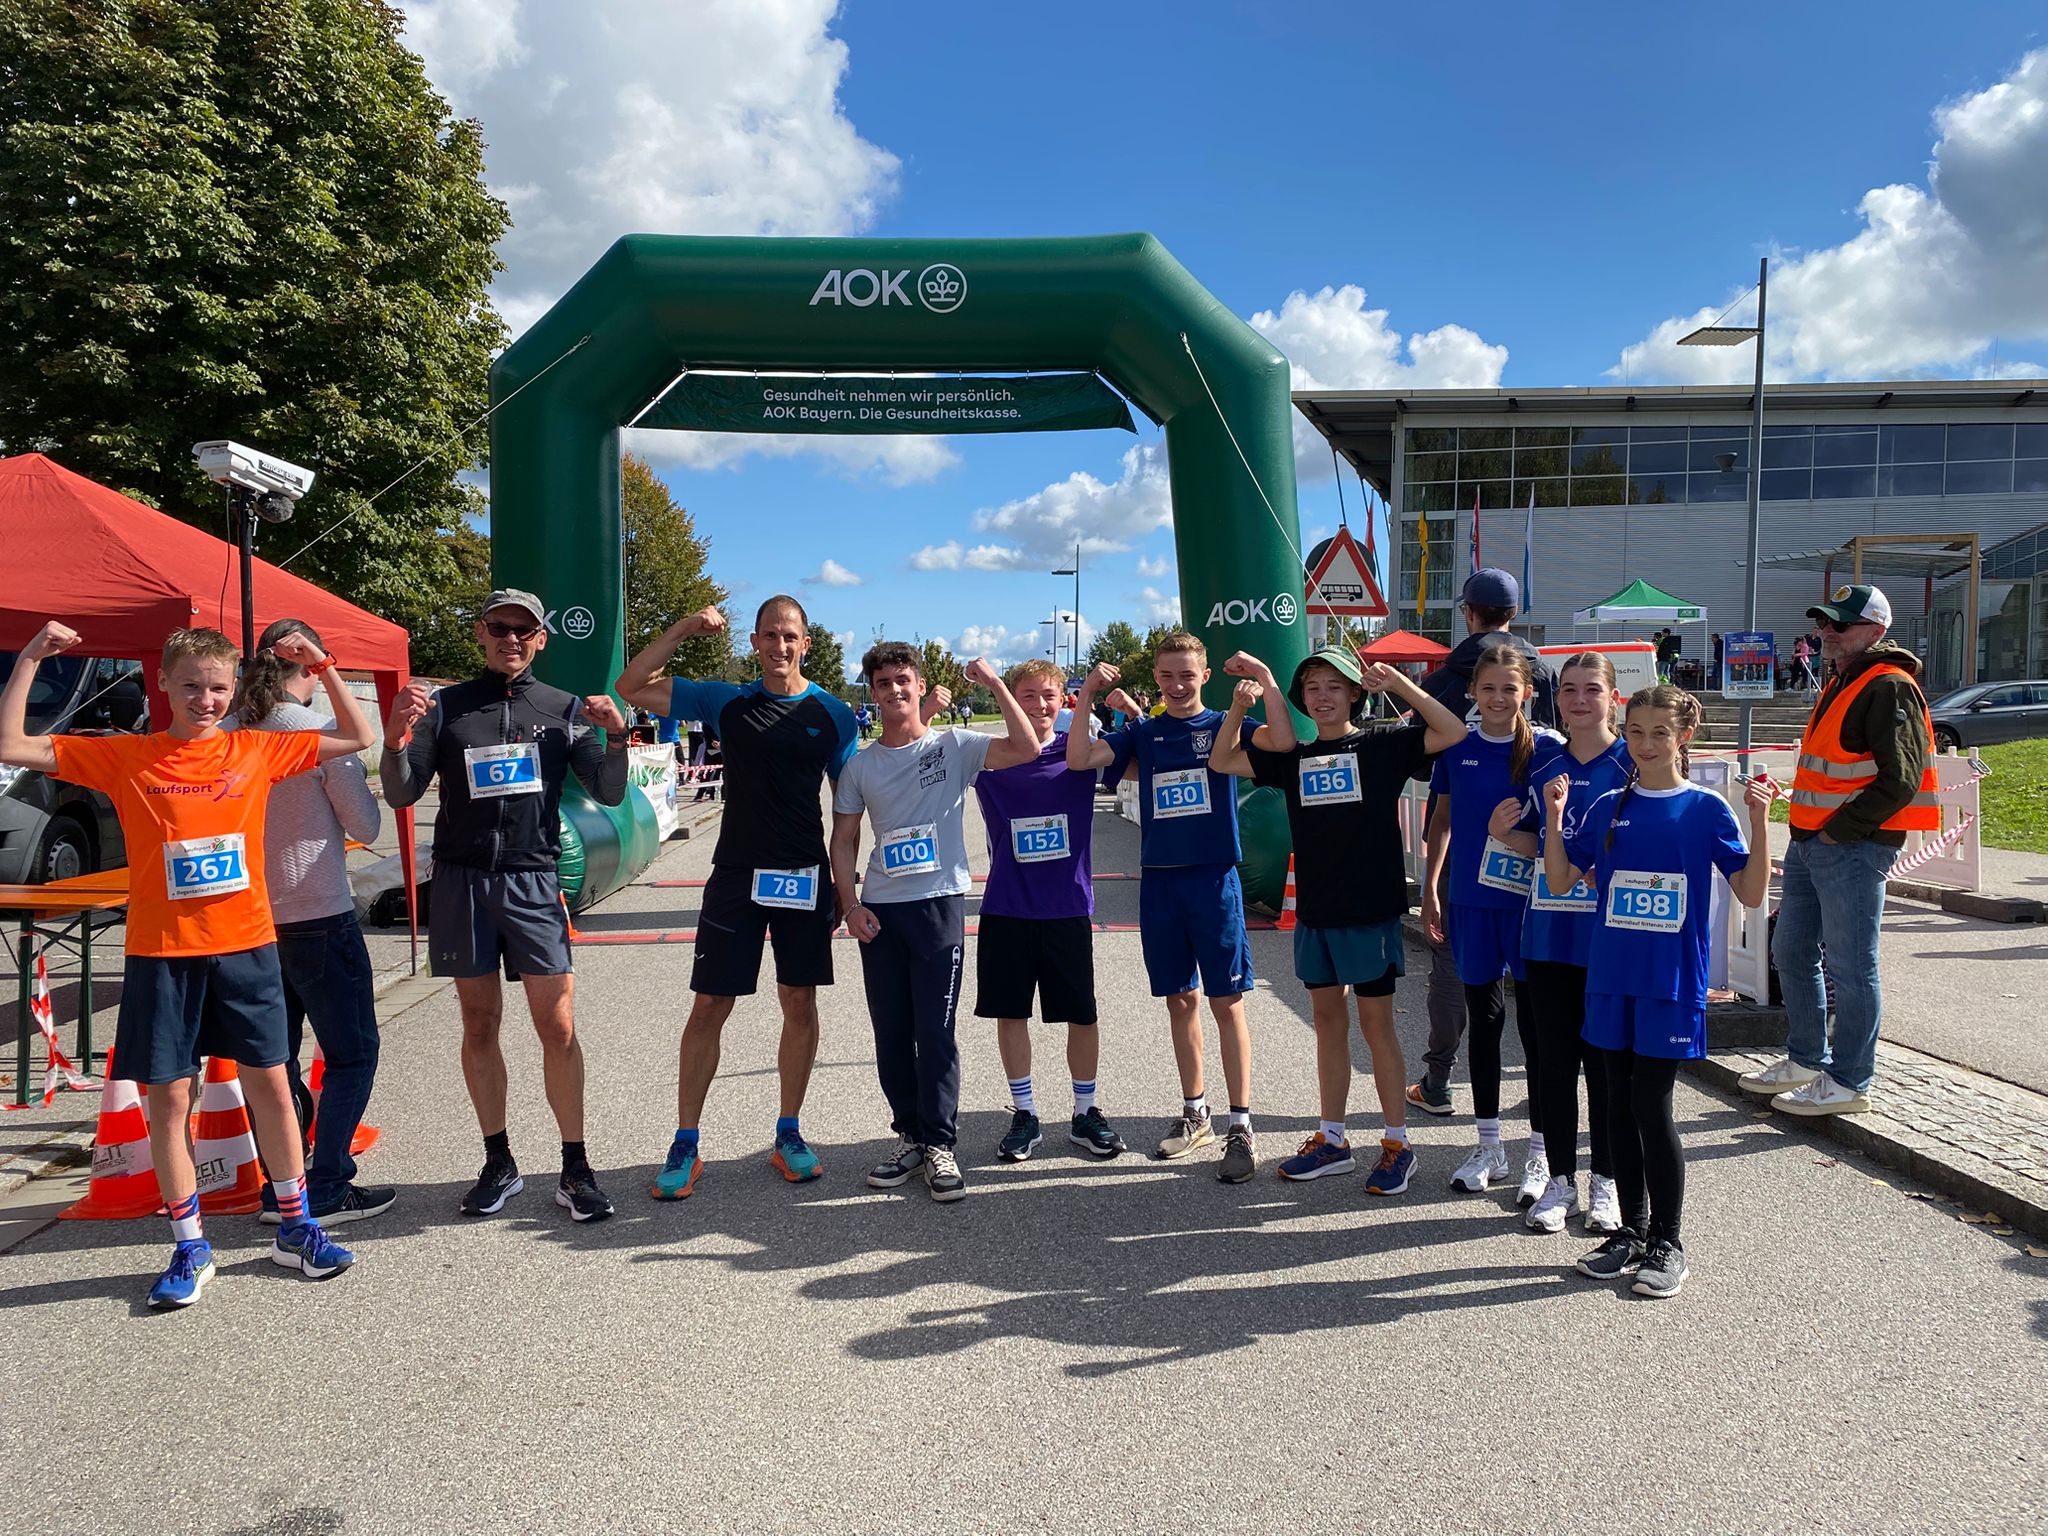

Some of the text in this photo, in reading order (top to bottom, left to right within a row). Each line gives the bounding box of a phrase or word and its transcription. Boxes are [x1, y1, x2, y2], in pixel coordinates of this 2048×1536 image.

[808, 269, 913, 307] AOK
[763, 388, 1015, 405] Gesundheit nehmen wir persönlich.
[763, 406, 1021, 423] AOK Bayern. Die Gesundheitskasse.
[1205, 598, 1271, 628] AOK
[1614, 667, 1641, 675] isches
[489, 761, 519, 783] 67
[921, 770, 946, 788] MARVEL
[1308, 771, 1347, 793] 136
[145, 783, 213, 796] Laufsport
[1161, 785, 1198, 806] 130
[1023, 831, 1060, 850] 152
[890, 841, 929, 864] 100
[182, 855, 234, 883] 267
[773, 877, 799, 897] 78
[1622, 891, 1670, 917] 198
[1611, 918, 1641, 927] Regentallauf
[1640, 921, 1664, 929] Nittenau
[944, 945, 961, 1028] Champion
[195, 1157, 226, 1181] ZEIT
